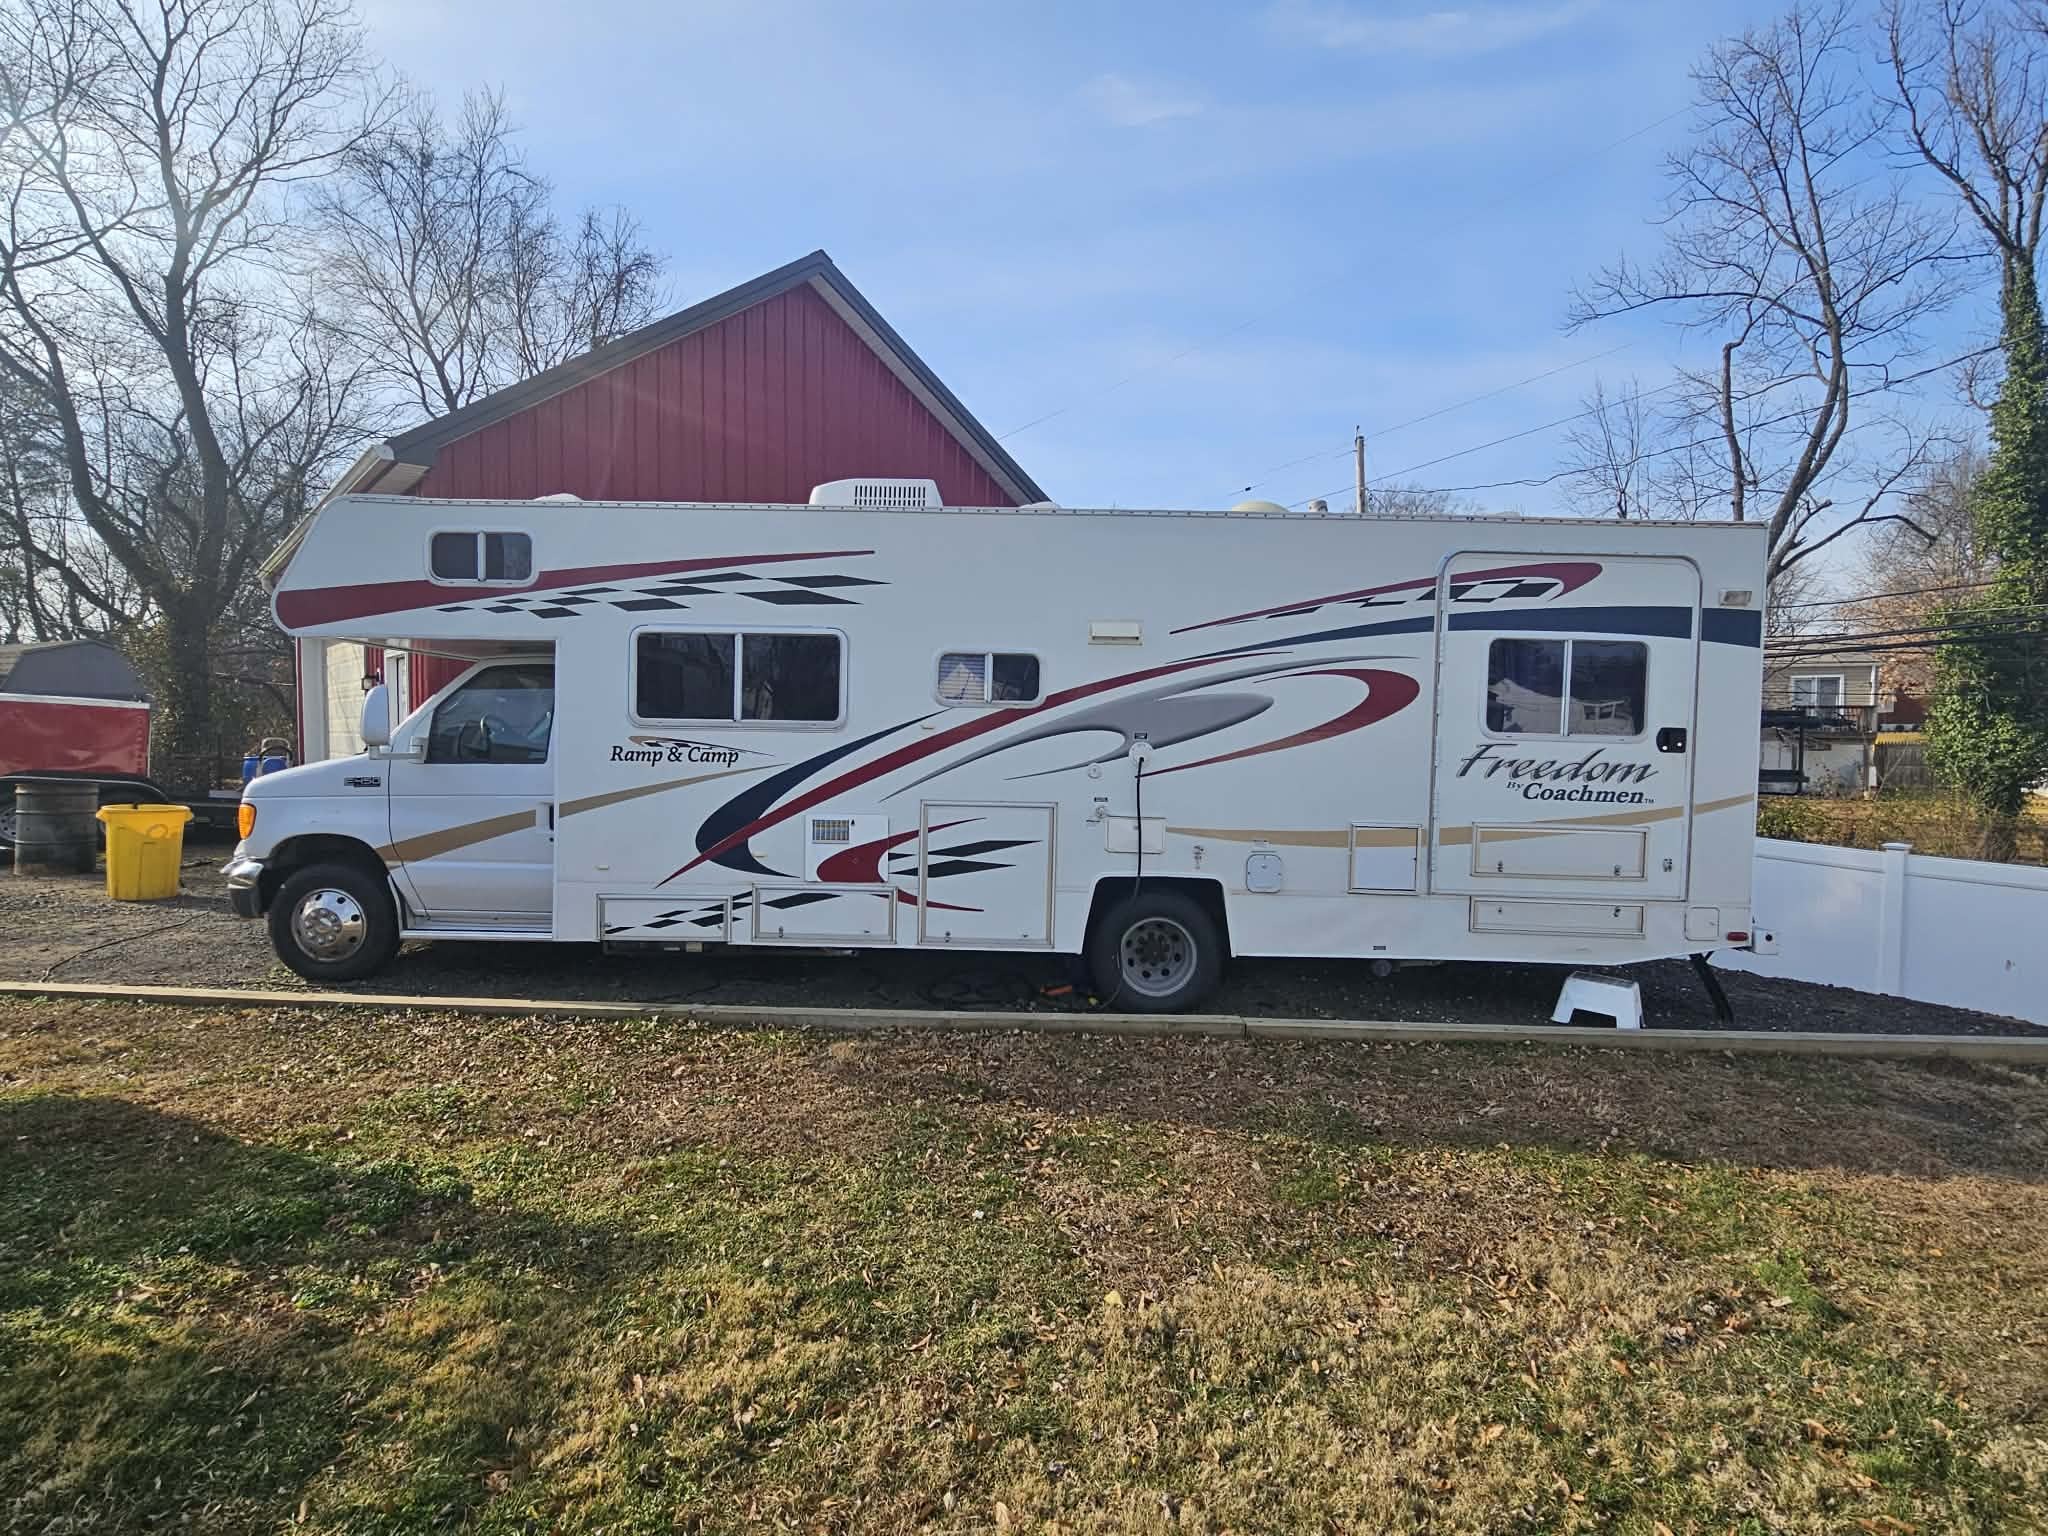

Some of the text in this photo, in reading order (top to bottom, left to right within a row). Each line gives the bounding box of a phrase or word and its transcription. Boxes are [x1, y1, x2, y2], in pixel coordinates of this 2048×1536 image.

[610, 746, 739, 767] Ramp & Camp
[1456, 743, 1658, 784] Freedom
[1506, 781, 1523, 791] By
[1522, 782, 1644, 804] Coachmen
